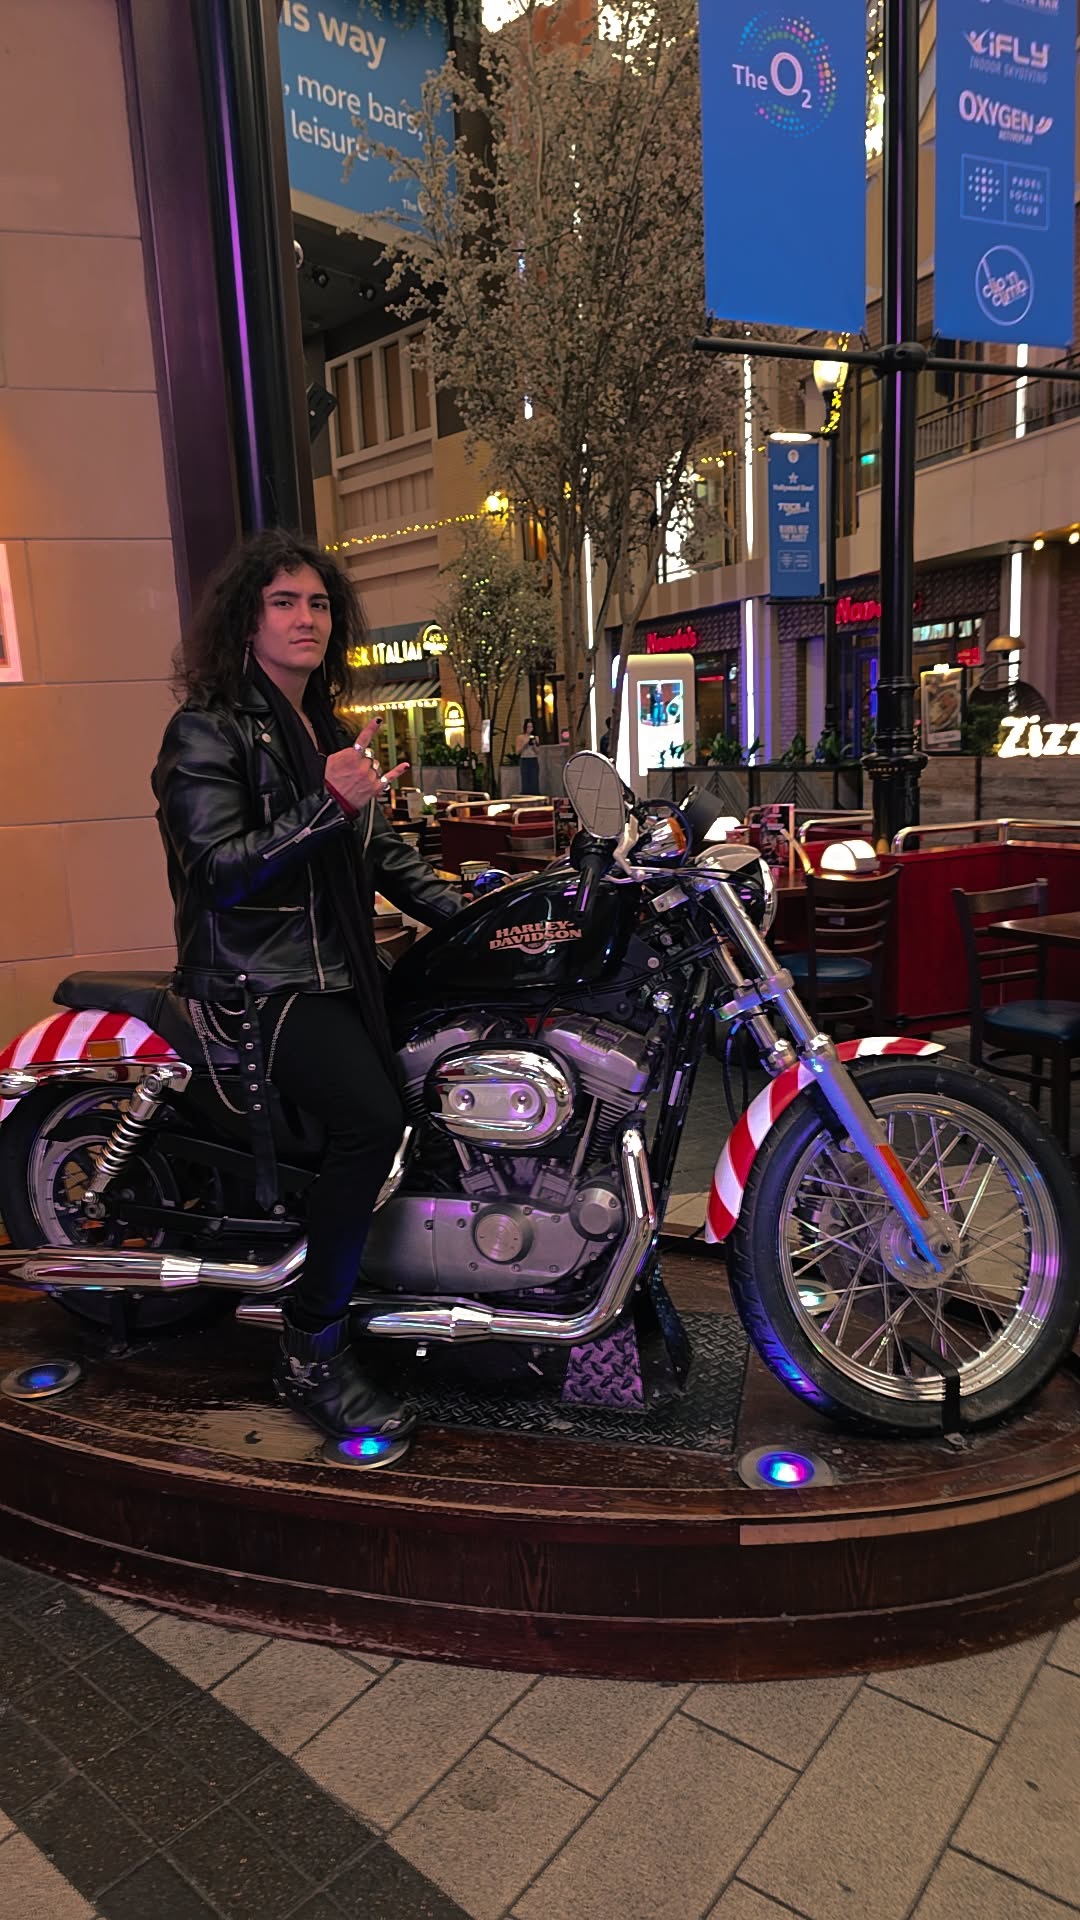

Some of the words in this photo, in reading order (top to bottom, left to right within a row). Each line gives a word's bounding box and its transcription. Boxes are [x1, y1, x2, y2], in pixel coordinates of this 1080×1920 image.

[280, 0, 310, 32] is
[318, 12, 386, 70] way
[732, 63, 768, 91] The
[298, 74, 361, 115] more
[368, 92, 423, 142] bars,
[959, 90, 1034, 133] OXYGEN
[290, 108, 370, 161] leisure
[489, 929, 582, 949] DAVIDSON
